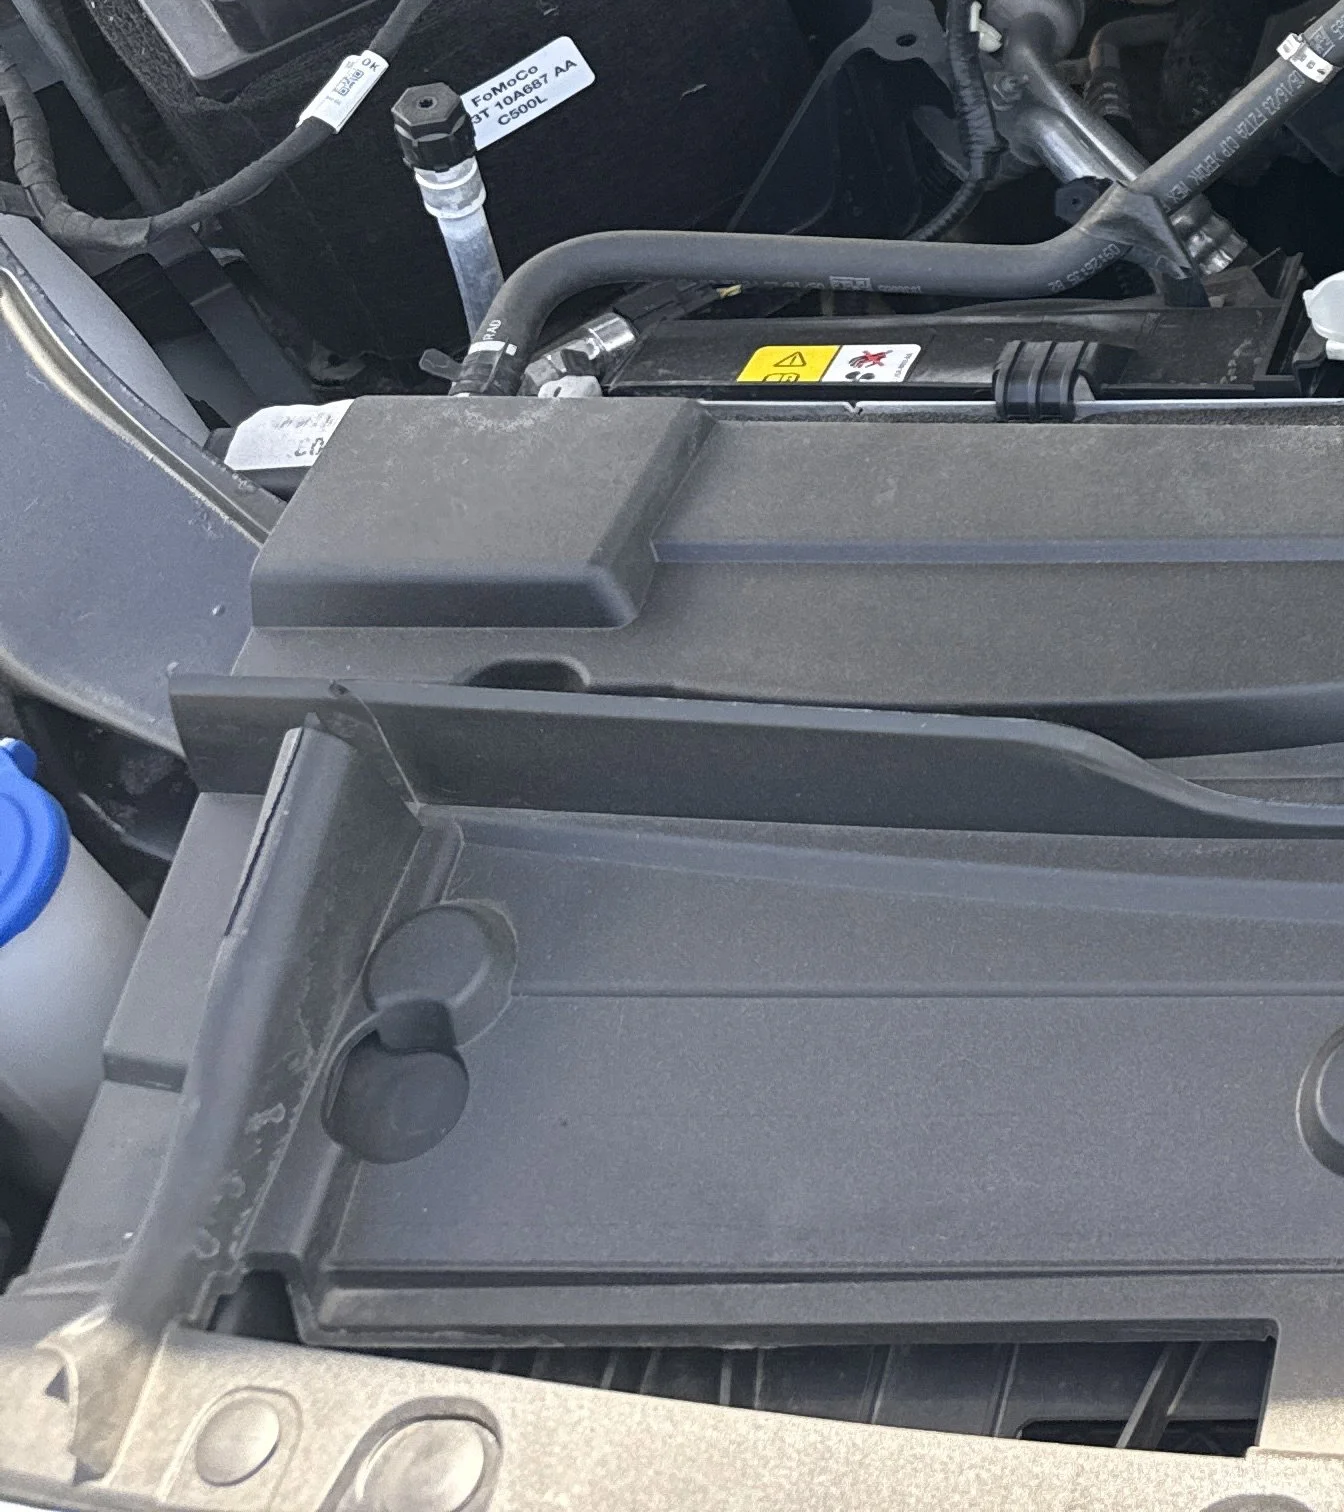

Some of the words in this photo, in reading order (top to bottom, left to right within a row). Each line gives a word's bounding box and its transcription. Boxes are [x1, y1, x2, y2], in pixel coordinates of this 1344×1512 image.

[361, 57, 380, 72] OK
[471, 64, 539, 108] FoMoCo
[494, 74, 550, 111] 10A687
[554, 59, 578, 77] AA
[497, 94, 548, 126] C500L
[482, 319, 502, 341] RAD
